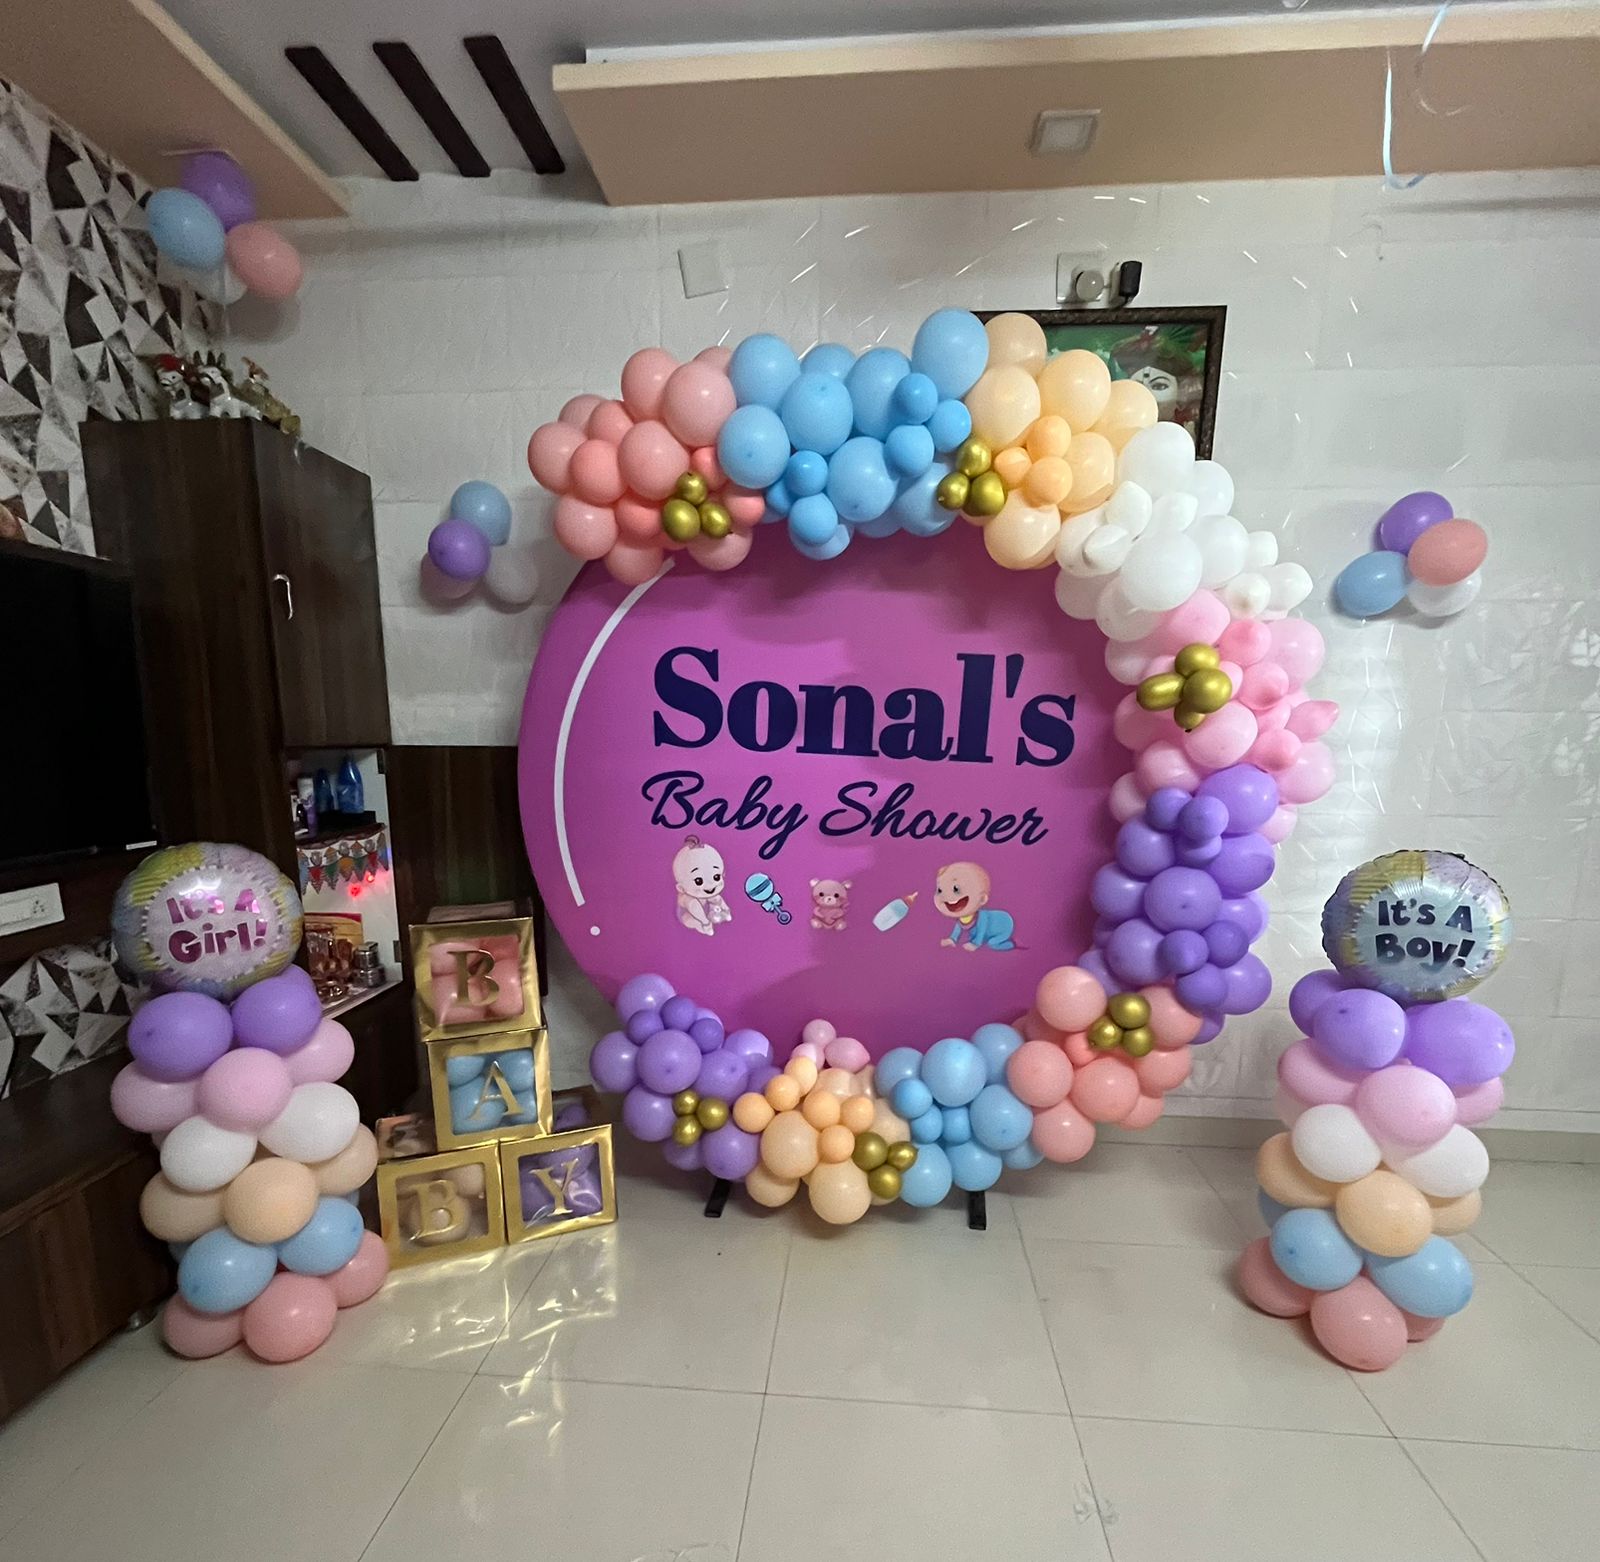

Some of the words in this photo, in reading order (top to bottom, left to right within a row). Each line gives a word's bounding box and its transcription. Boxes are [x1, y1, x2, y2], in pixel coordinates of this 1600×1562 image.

[653, 646, 1076, 767] Sonal's
[641, 770, 808, 859] Baby
[819, 782, 1048, 845] Shower
[234, 888, 261, 914] A
[1378, 898, 1436, 927] It's
[1445, 905, 1473, 933] A
[168, 919, 267, 964] Girl!
[1375, 933, 1476, 972] Boy!
[447, 949, 500, 1006] B
[466, 1059, 525, 1121] A
[408, 1178, 469, 1241] B
[530, 1157, 580, 1216] Y
